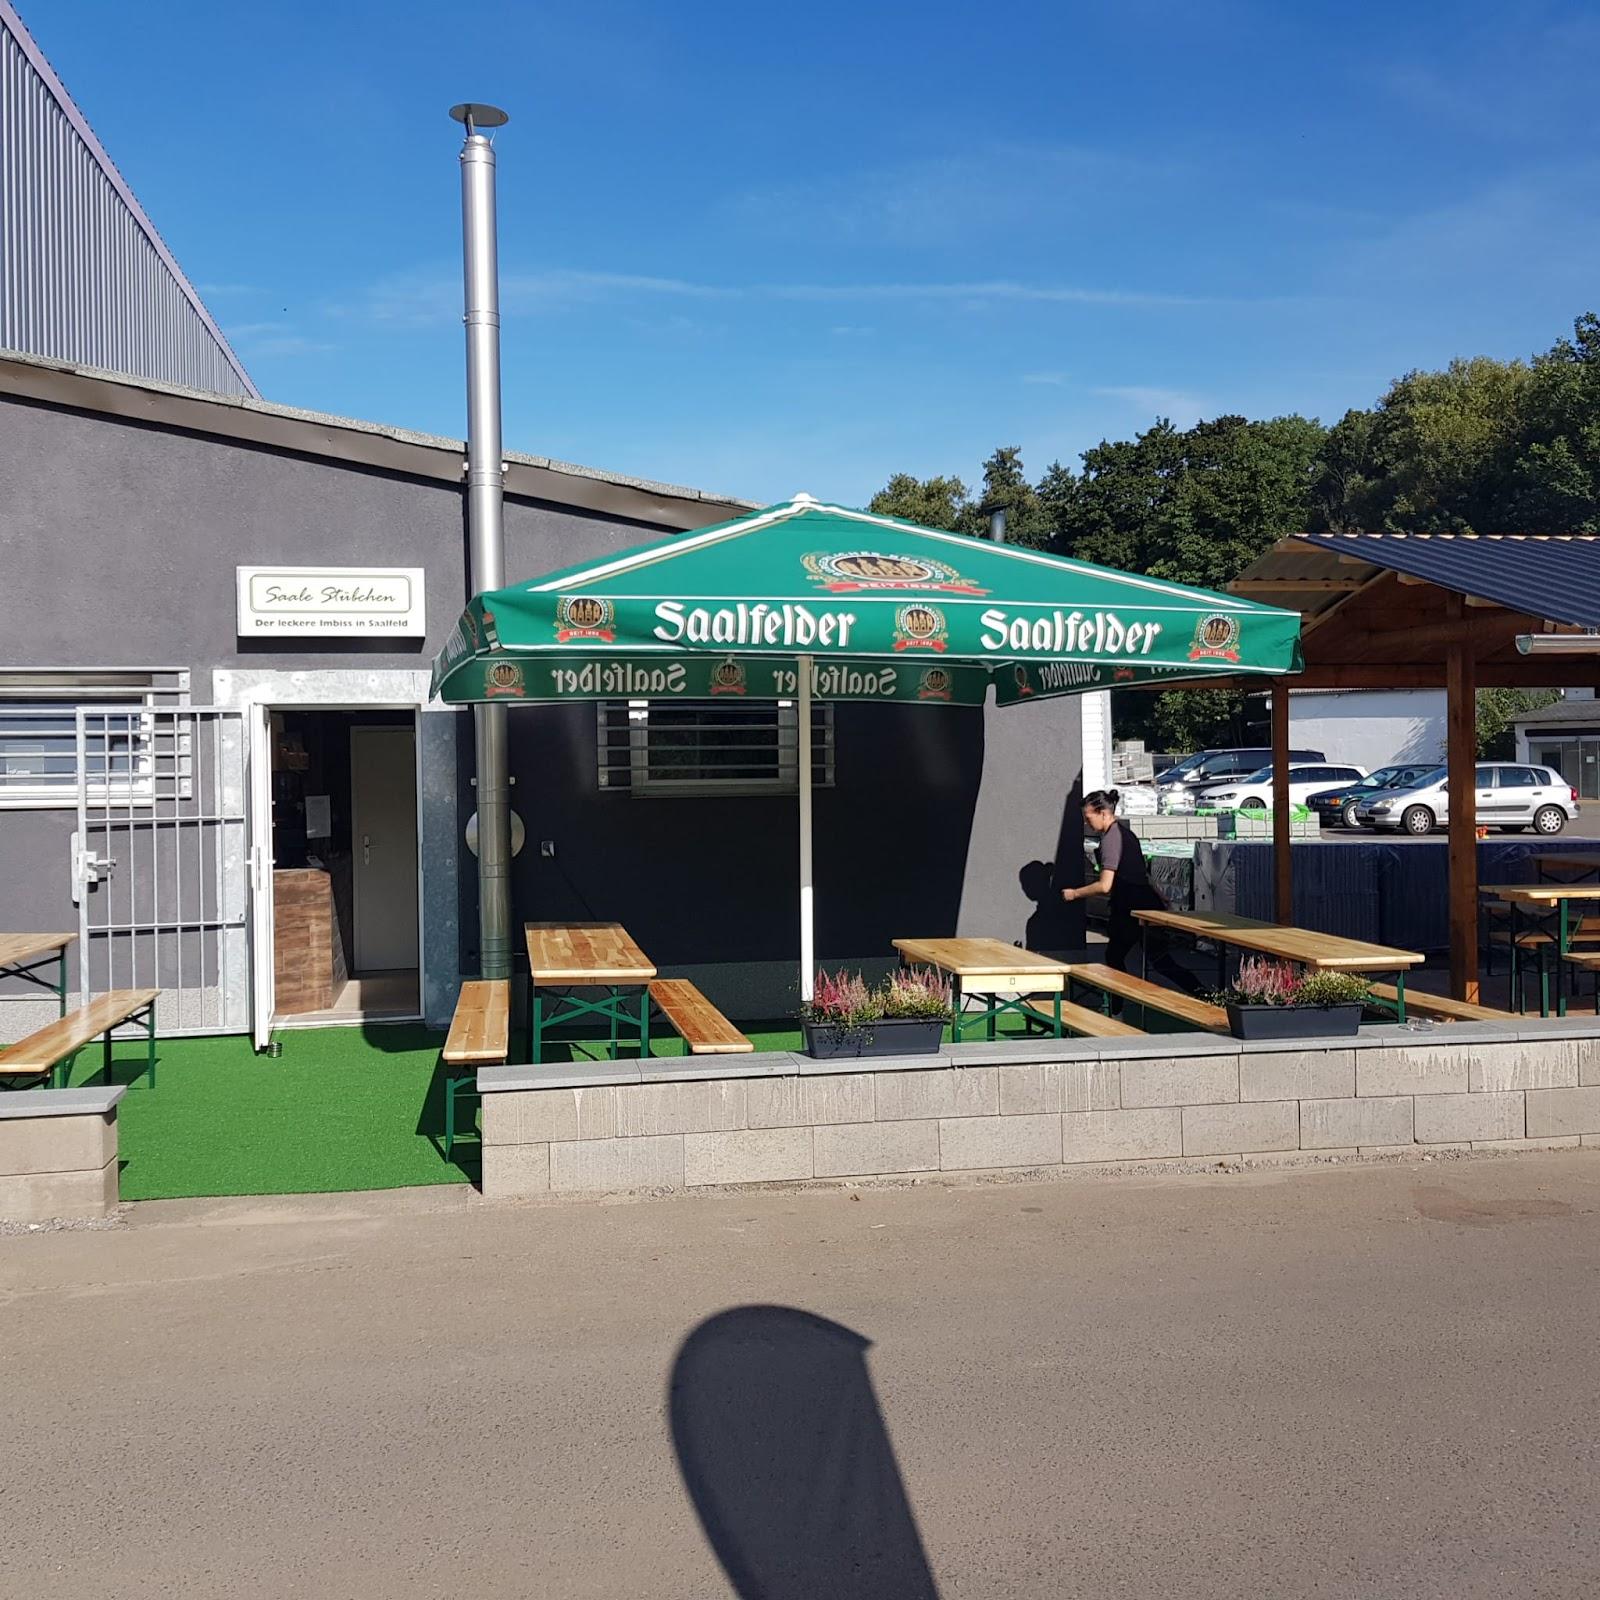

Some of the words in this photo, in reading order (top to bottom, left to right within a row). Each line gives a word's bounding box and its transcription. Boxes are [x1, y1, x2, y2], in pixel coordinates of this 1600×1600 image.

[265, 586, 314, 603] Saale
[320, 586, 396, 603] Stübchen
[255, 619, 275, 627] Der
[278, 619, 316, 627] leckere
[320, 619, 353, 627] Imbiss
[356, 619, 366, 627] in
[368, 619, 408, 627] Saalfeld
[653, 601, 858, 647] Saalfelder
[980, 608, 1163, 655] Saalfelder
